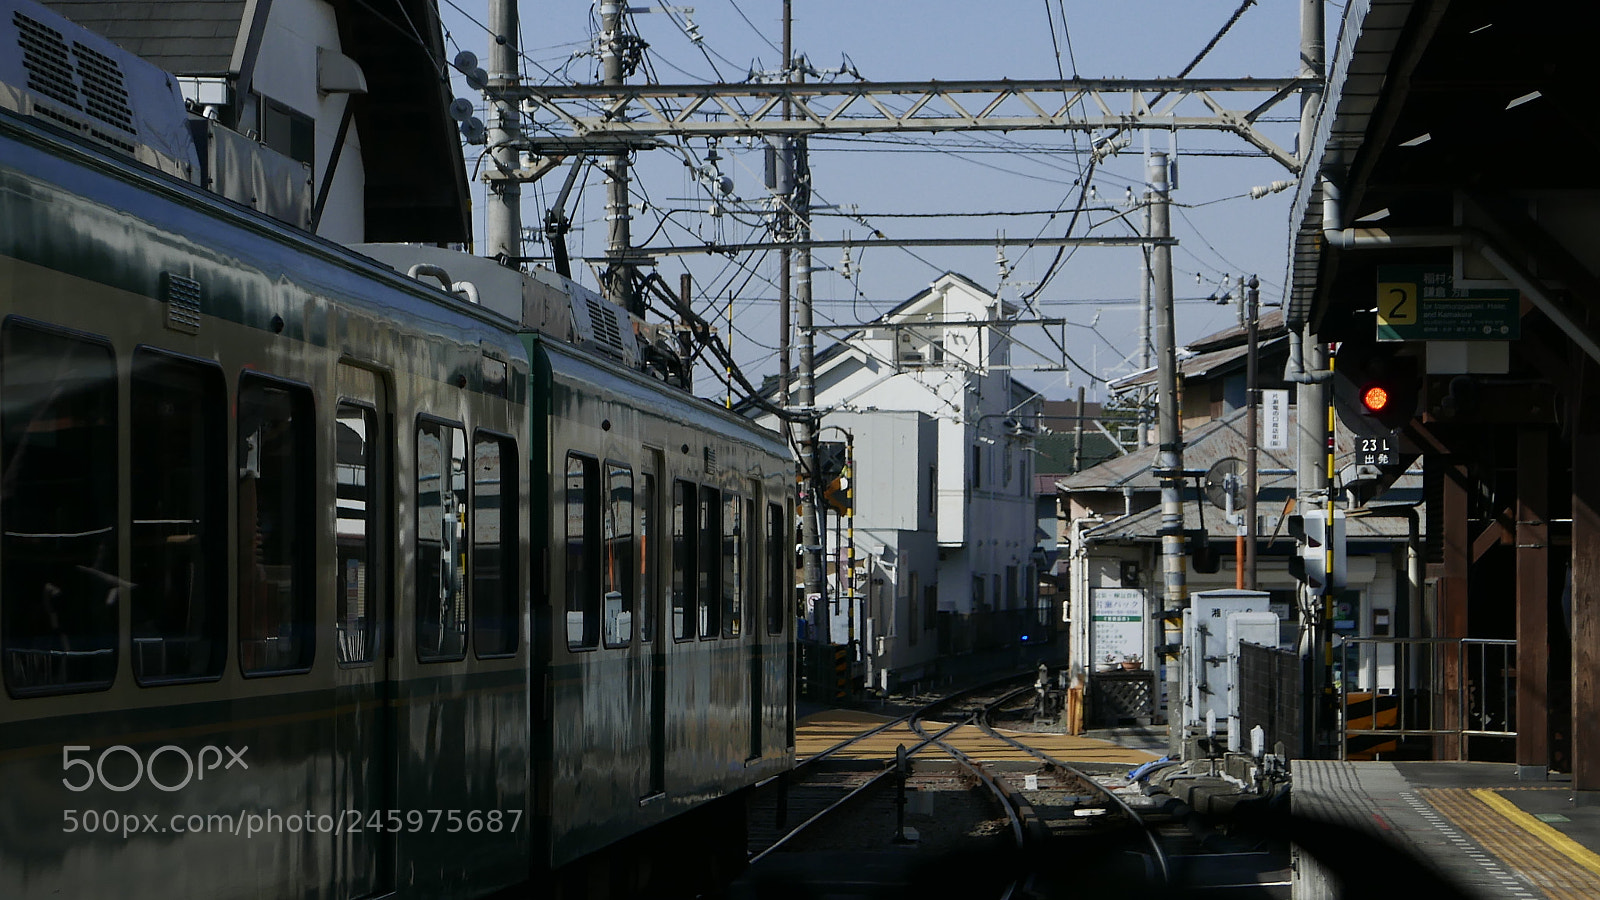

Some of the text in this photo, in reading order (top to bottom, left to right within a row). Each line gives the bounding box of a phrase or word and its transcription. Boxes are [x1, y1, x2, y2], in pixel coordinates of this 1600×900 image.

[1389, 288, 1408, 319] 2
[1362, 439, 1390, 452] 23 L
[1364, 453, 1389, 465] 出発
